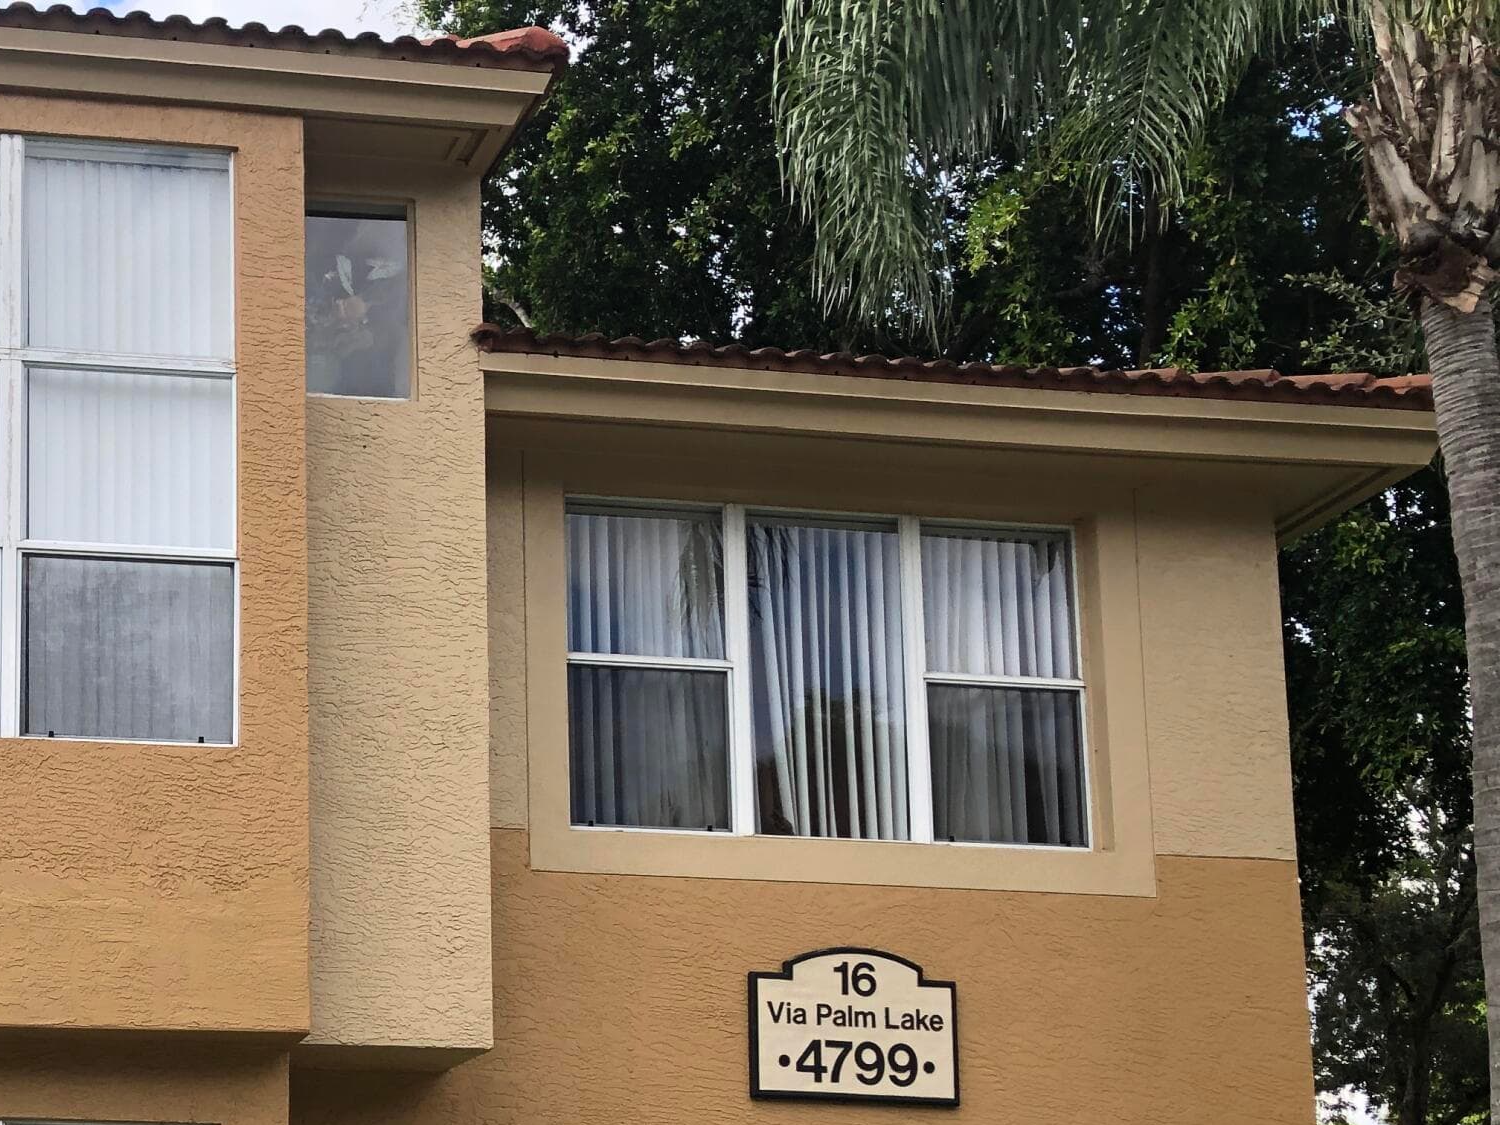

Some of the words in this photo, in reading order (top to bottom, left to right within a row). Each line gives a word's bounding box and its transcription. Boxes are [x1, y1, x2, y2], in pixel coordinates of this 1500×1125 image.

[833, 961, 877, 997] 16
[767, 1001, 807, 1025] Via
[816, 1003, 876, 1028] Palm
[884, 1007, 944, 1032] Lake
